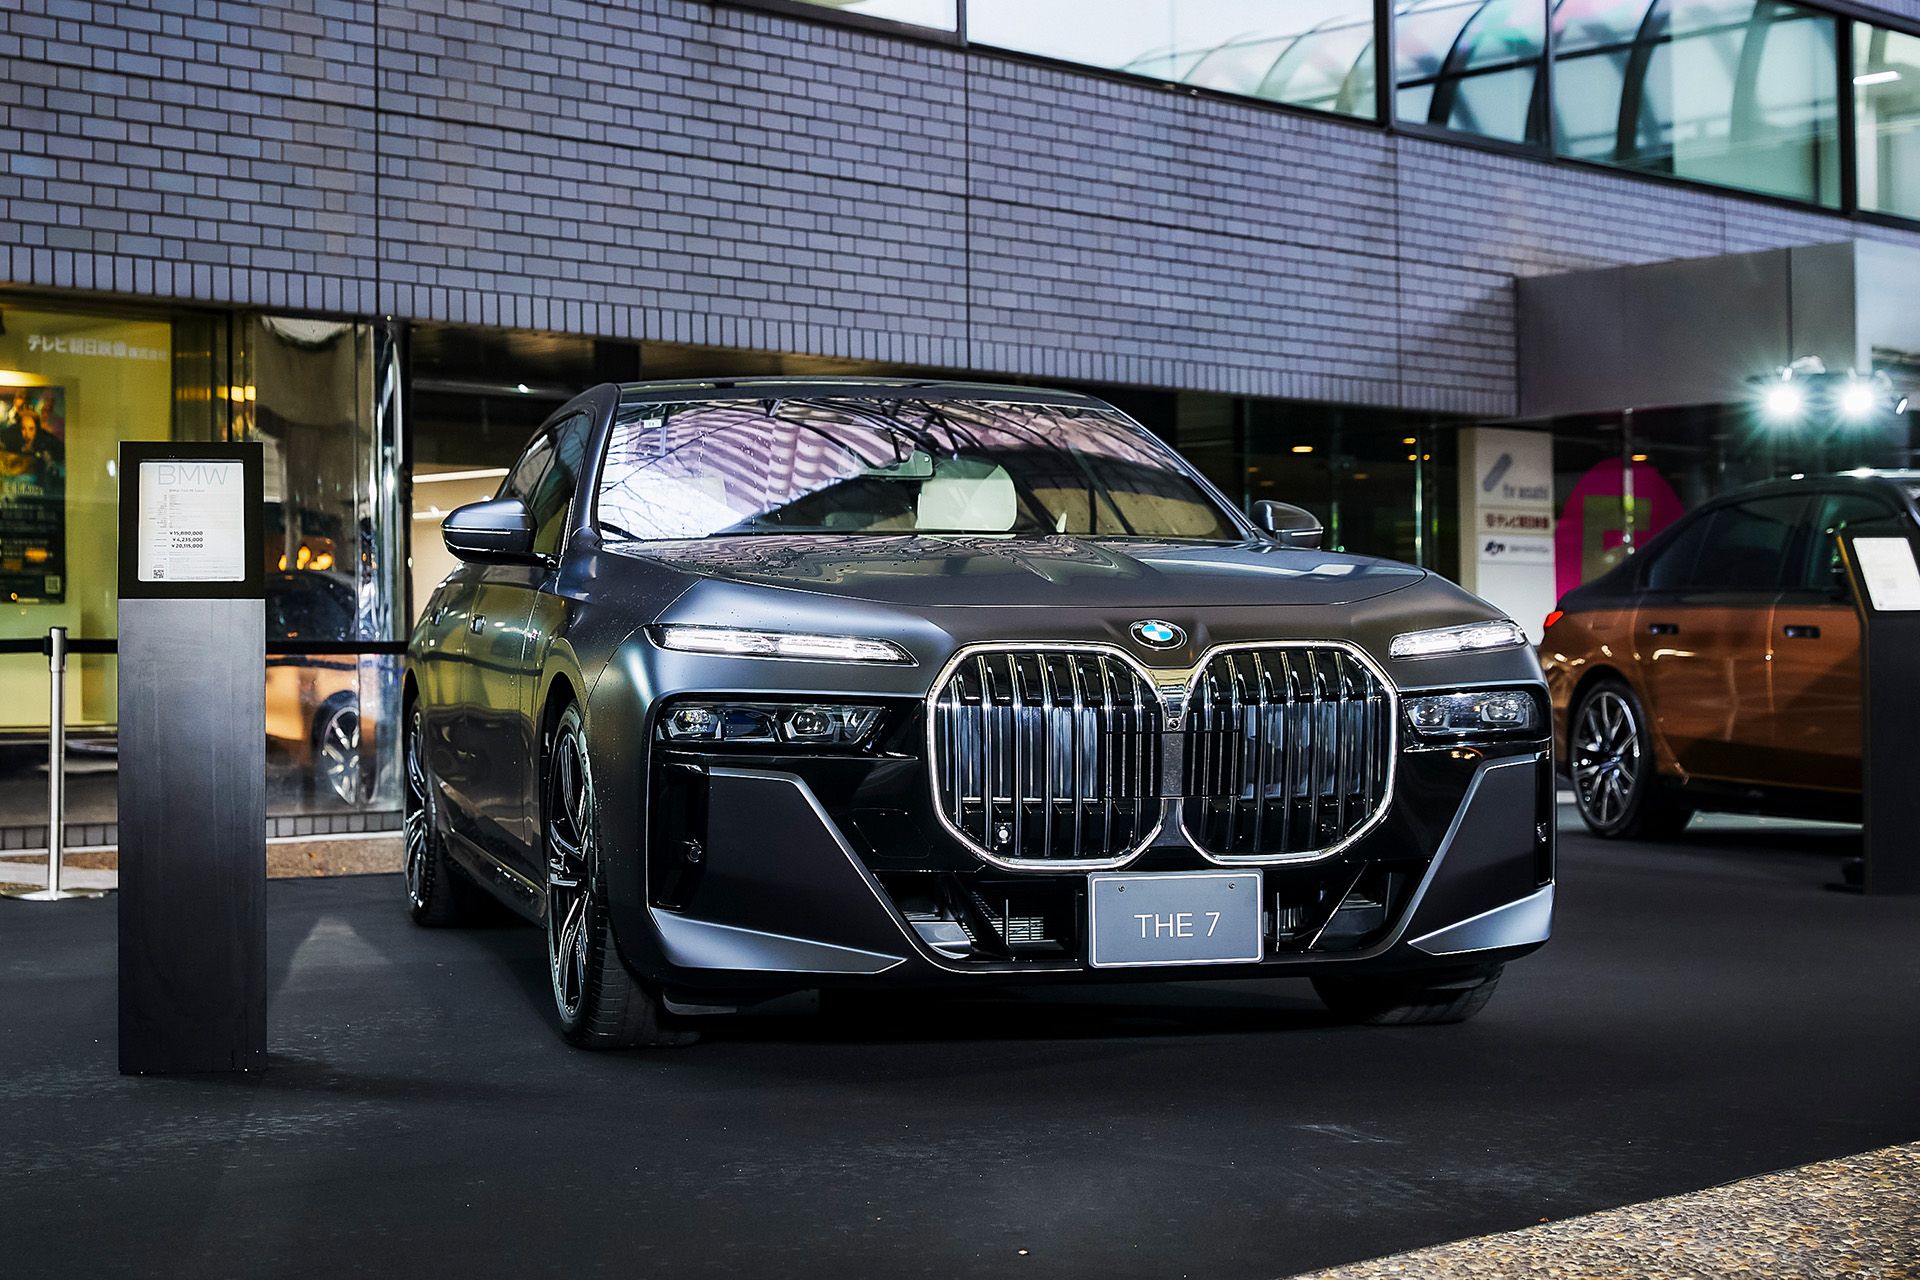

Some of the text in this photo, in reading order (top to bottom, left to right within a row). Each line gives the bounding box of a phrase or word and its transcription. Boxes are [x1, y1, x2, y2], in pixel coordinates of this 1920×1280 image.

[158, 464, 228, 486] BMW
[1133, 911, 1221, 939] THE 7
